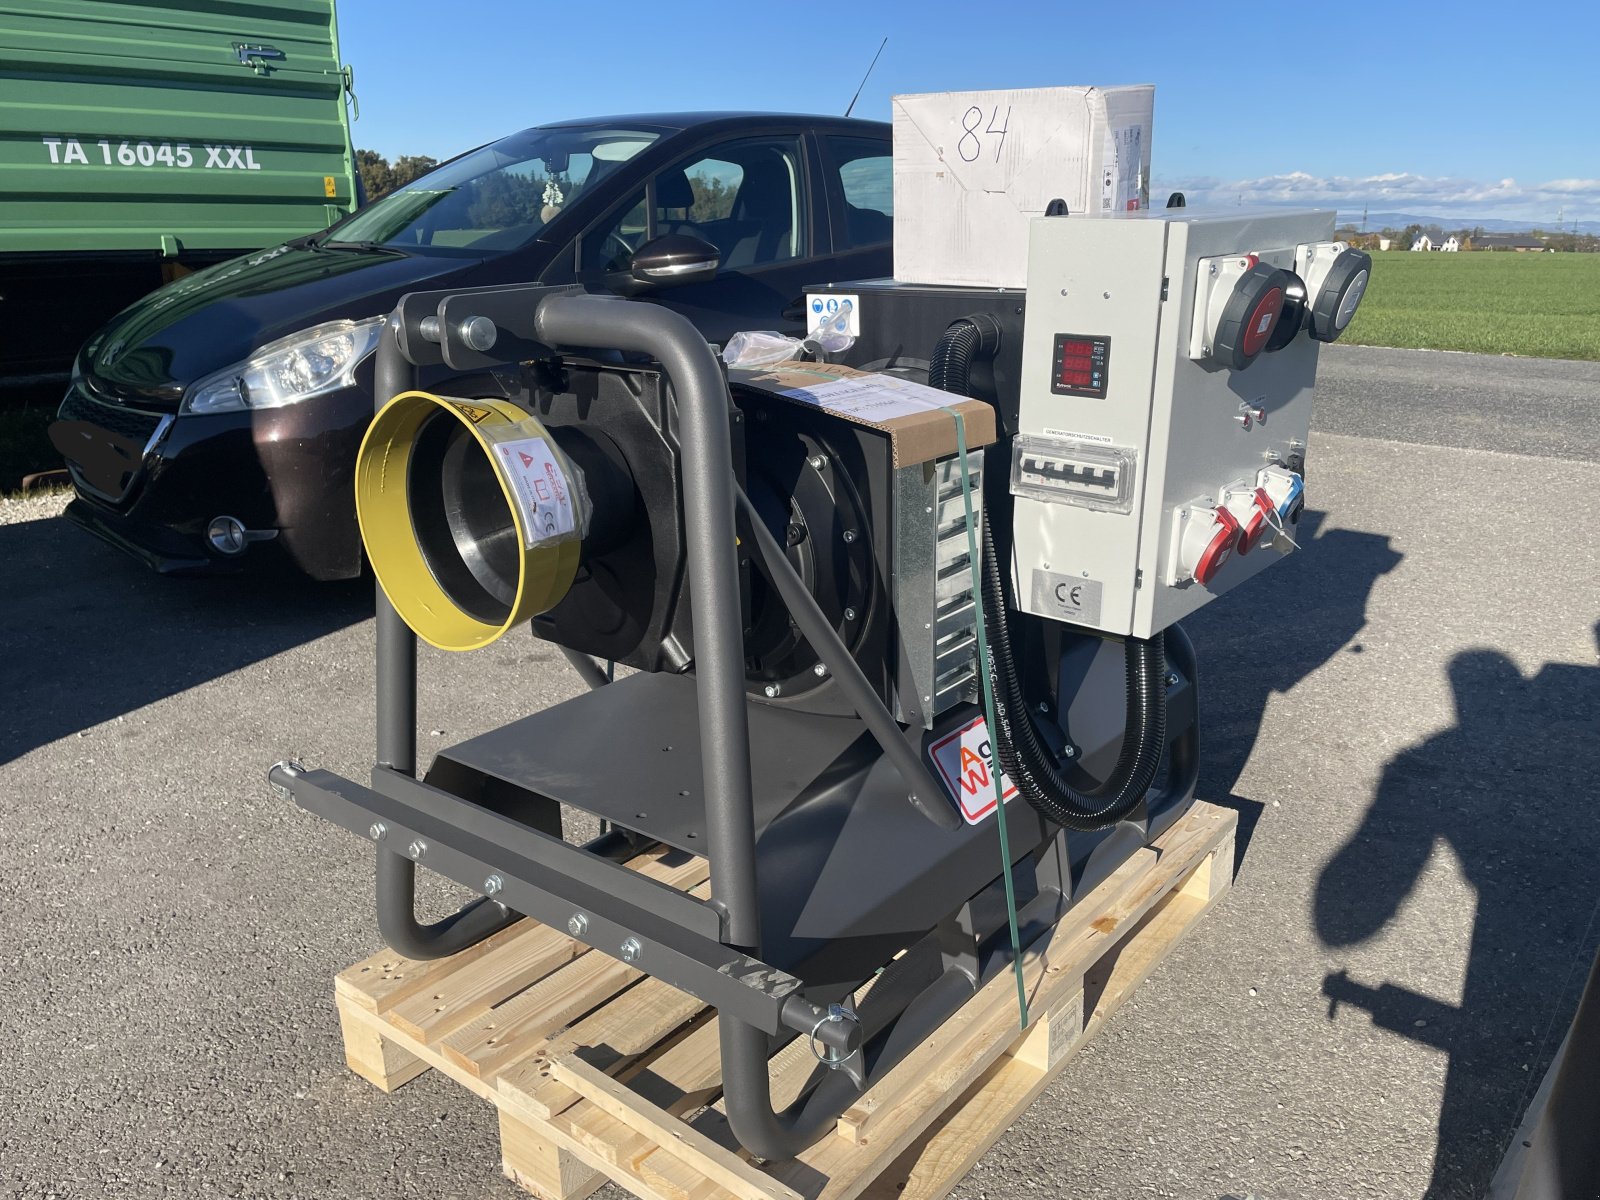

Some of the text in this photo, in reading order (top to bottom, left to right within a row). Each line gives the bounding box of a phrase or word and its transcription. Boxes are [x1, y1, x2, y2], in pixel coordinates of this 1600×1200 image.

[958, 105, 1011, 163] 84
[43, 137, 262, 170] TA 16045 XXL
[1055, 582, 1082, 606] CE
